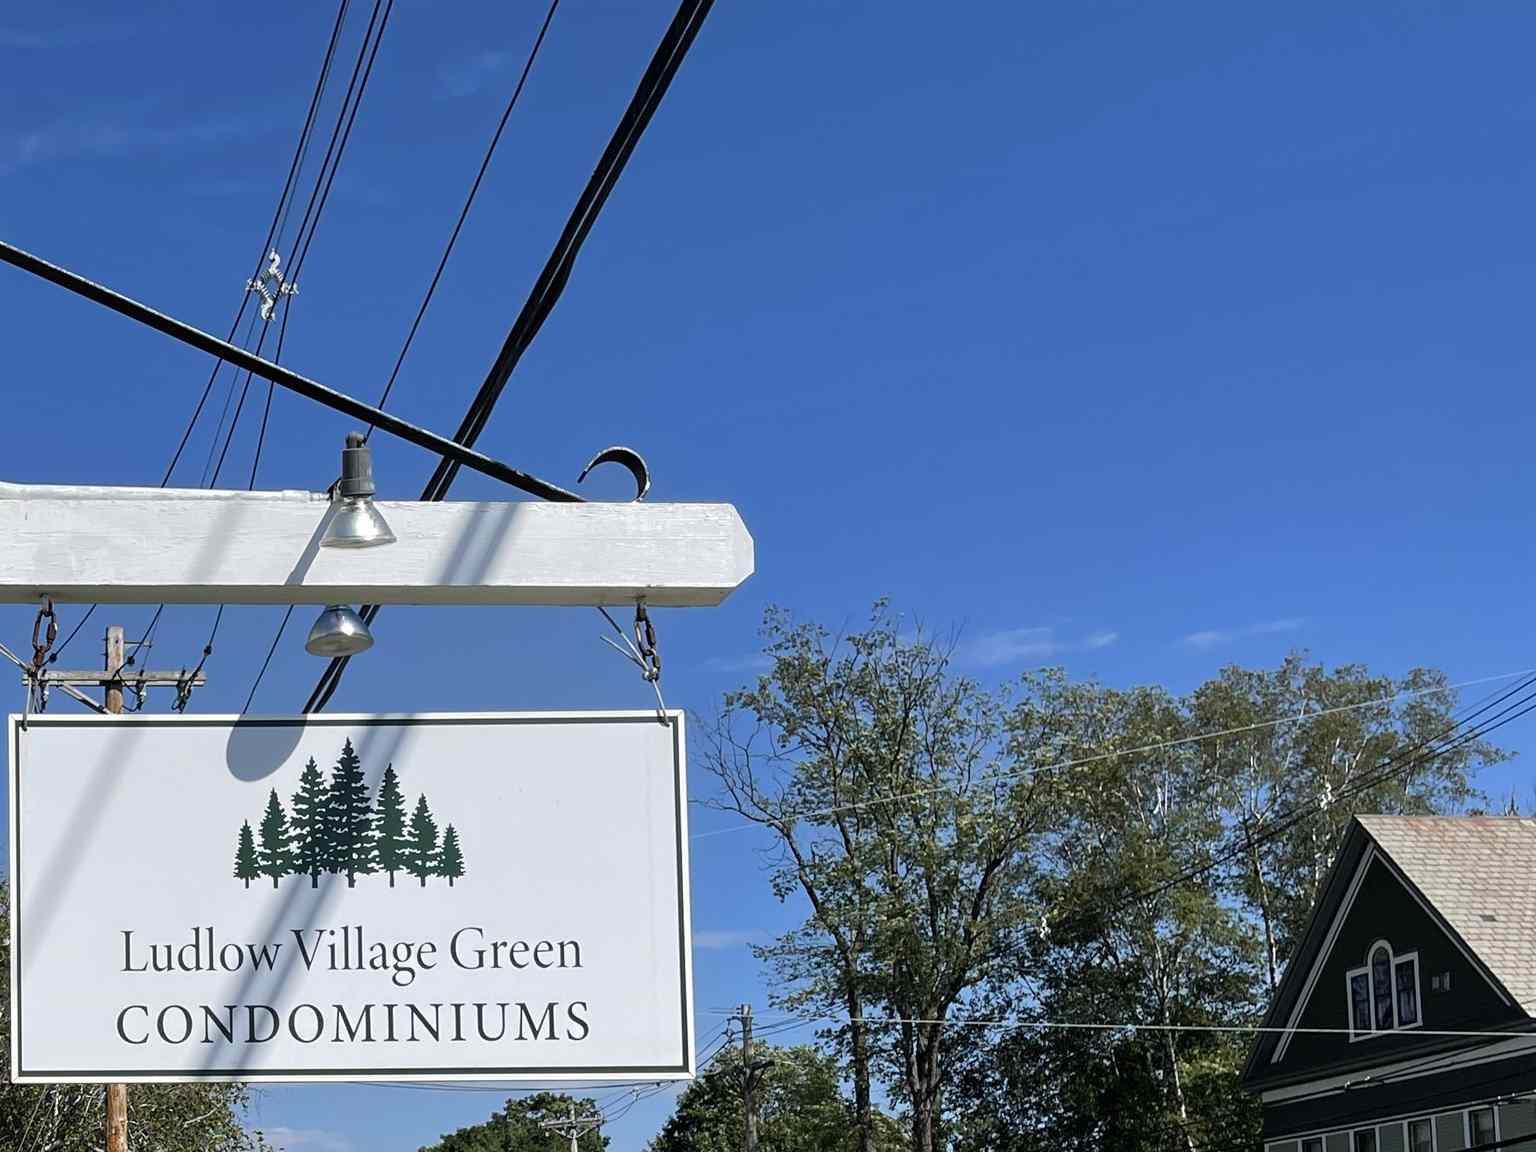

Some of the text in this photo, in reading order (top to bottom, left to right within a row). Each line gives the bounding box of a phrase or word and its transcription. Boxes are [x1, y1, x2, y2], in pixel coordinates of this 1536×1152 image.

[120, 924, 583, 987] Ludlow Village Green
[116, 1001, 591, 1046] CONDOMINIUMS
